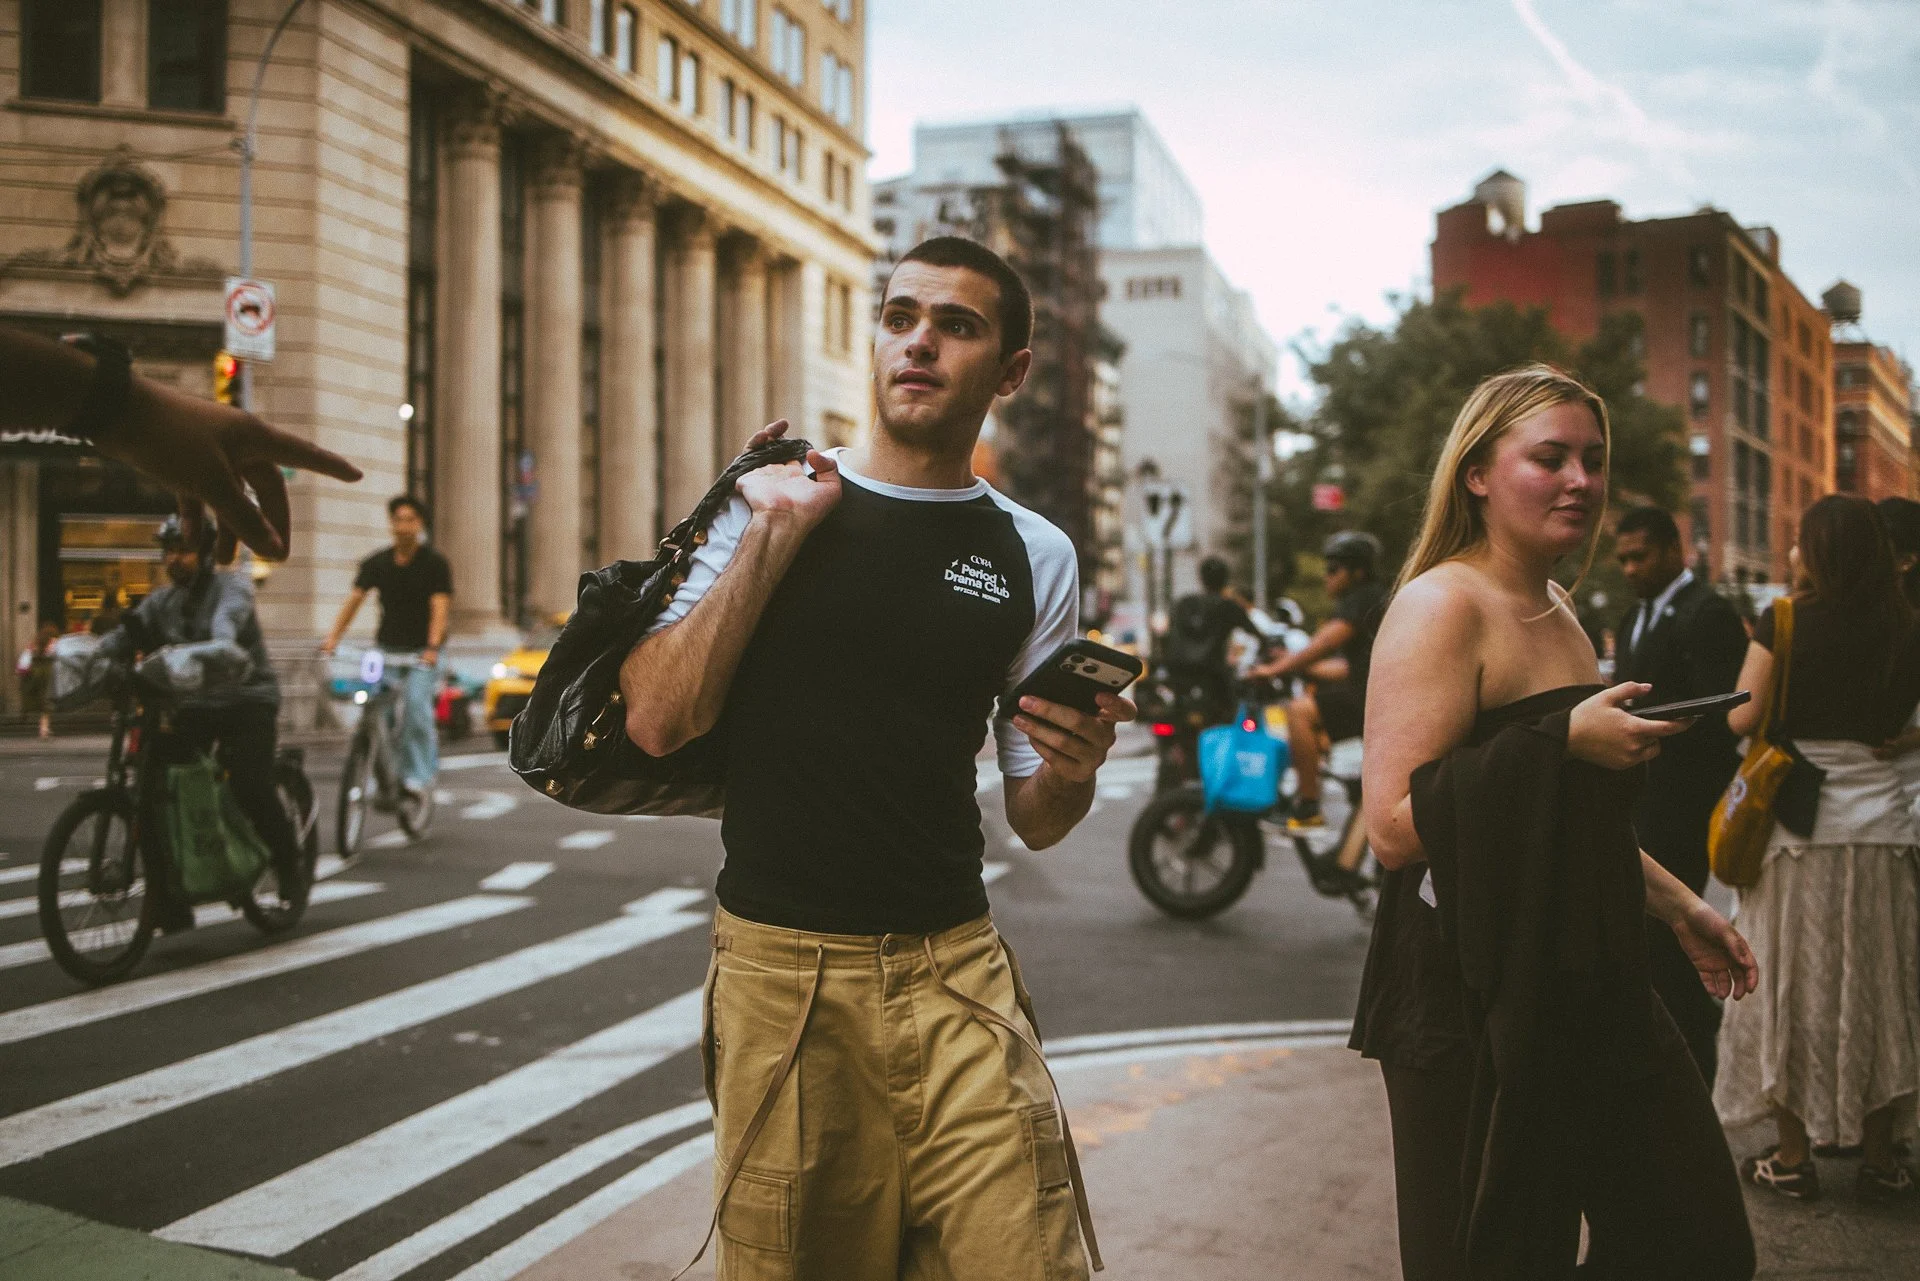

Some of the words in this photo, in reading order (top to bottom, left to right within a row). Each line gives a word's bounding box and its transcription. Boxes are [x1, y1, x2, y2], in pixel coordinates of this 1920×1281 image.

[970, 555, 992, 568] CORA
[944, 569, 982, 589] Drama
[984, 581, 1010, 599] Club
[962, 563, 997, 585] Period
